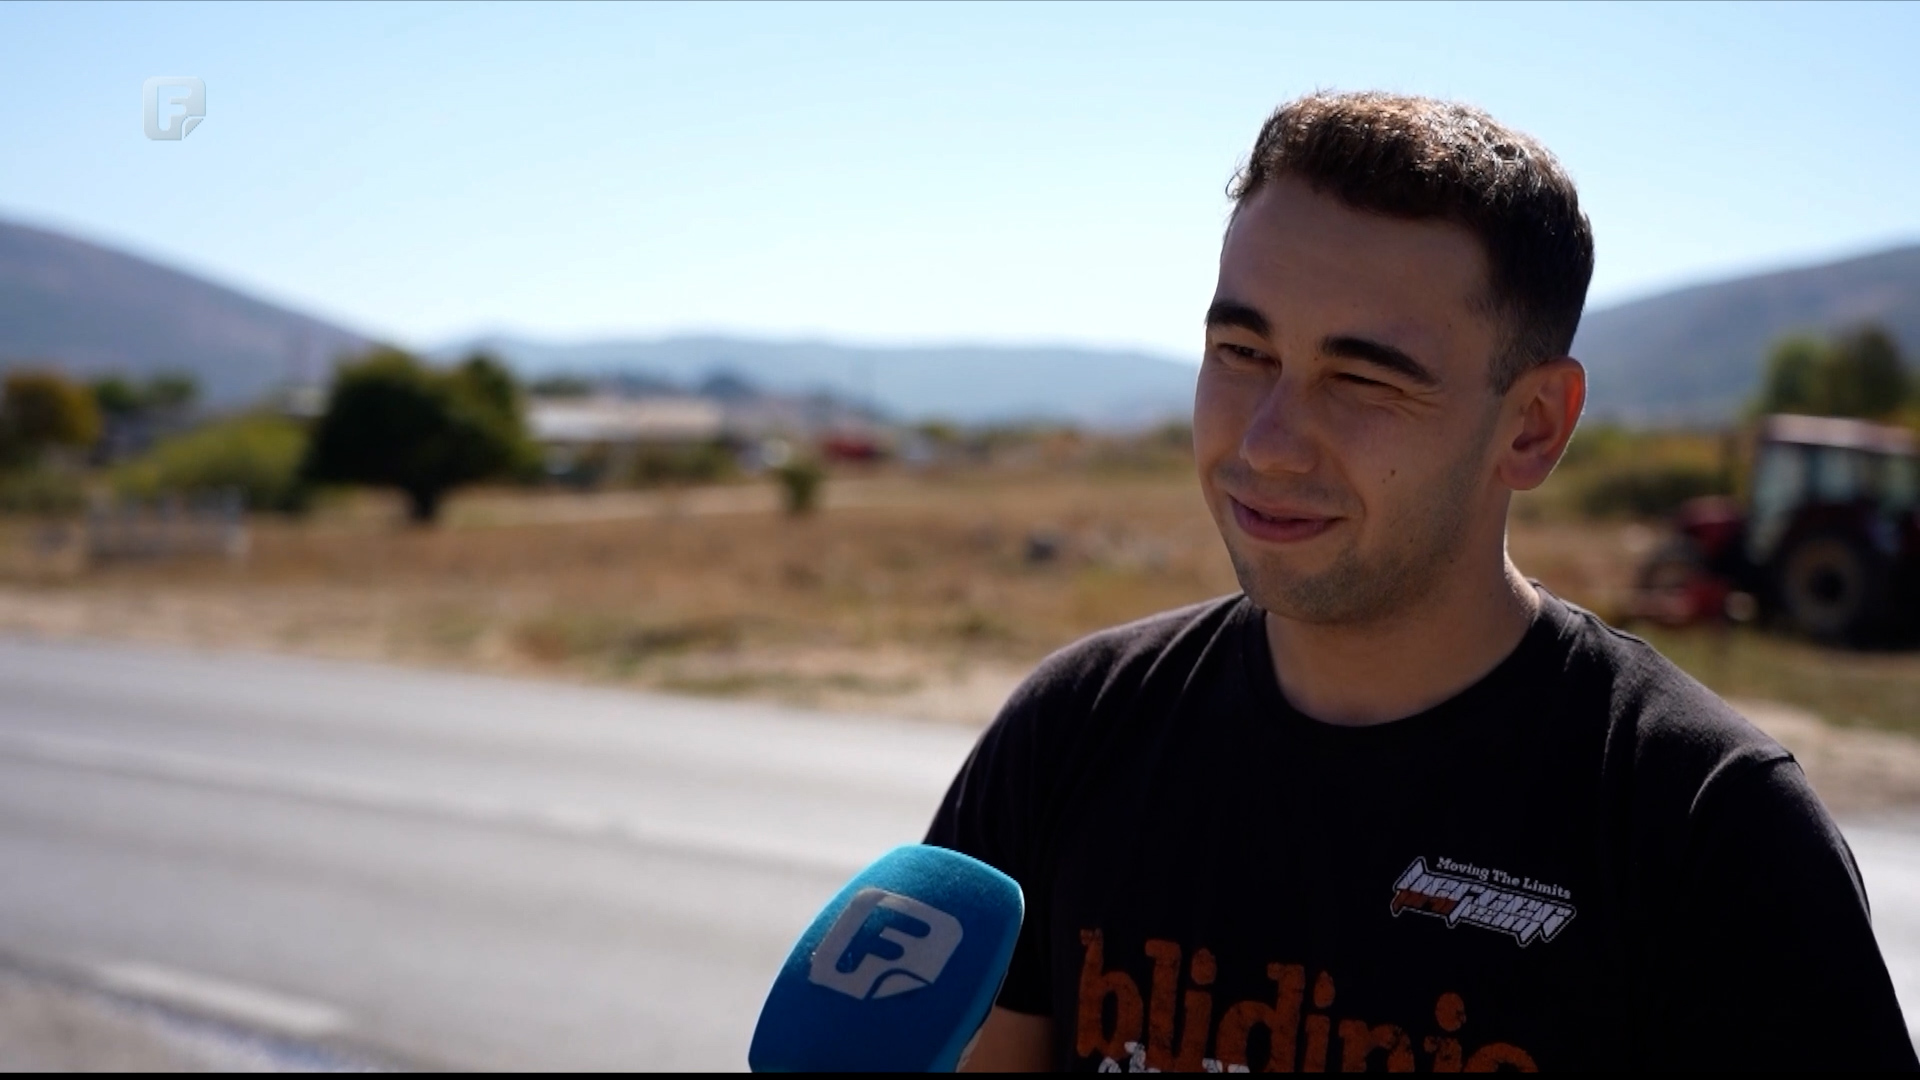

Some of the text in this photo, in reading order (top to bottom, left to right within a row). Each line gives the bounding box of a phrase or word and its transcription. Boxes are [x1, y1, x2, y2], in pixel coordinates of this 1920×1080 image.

[1436, 856, 1571, 899] Moving The Limits
[836, 905, 932, 974] F
